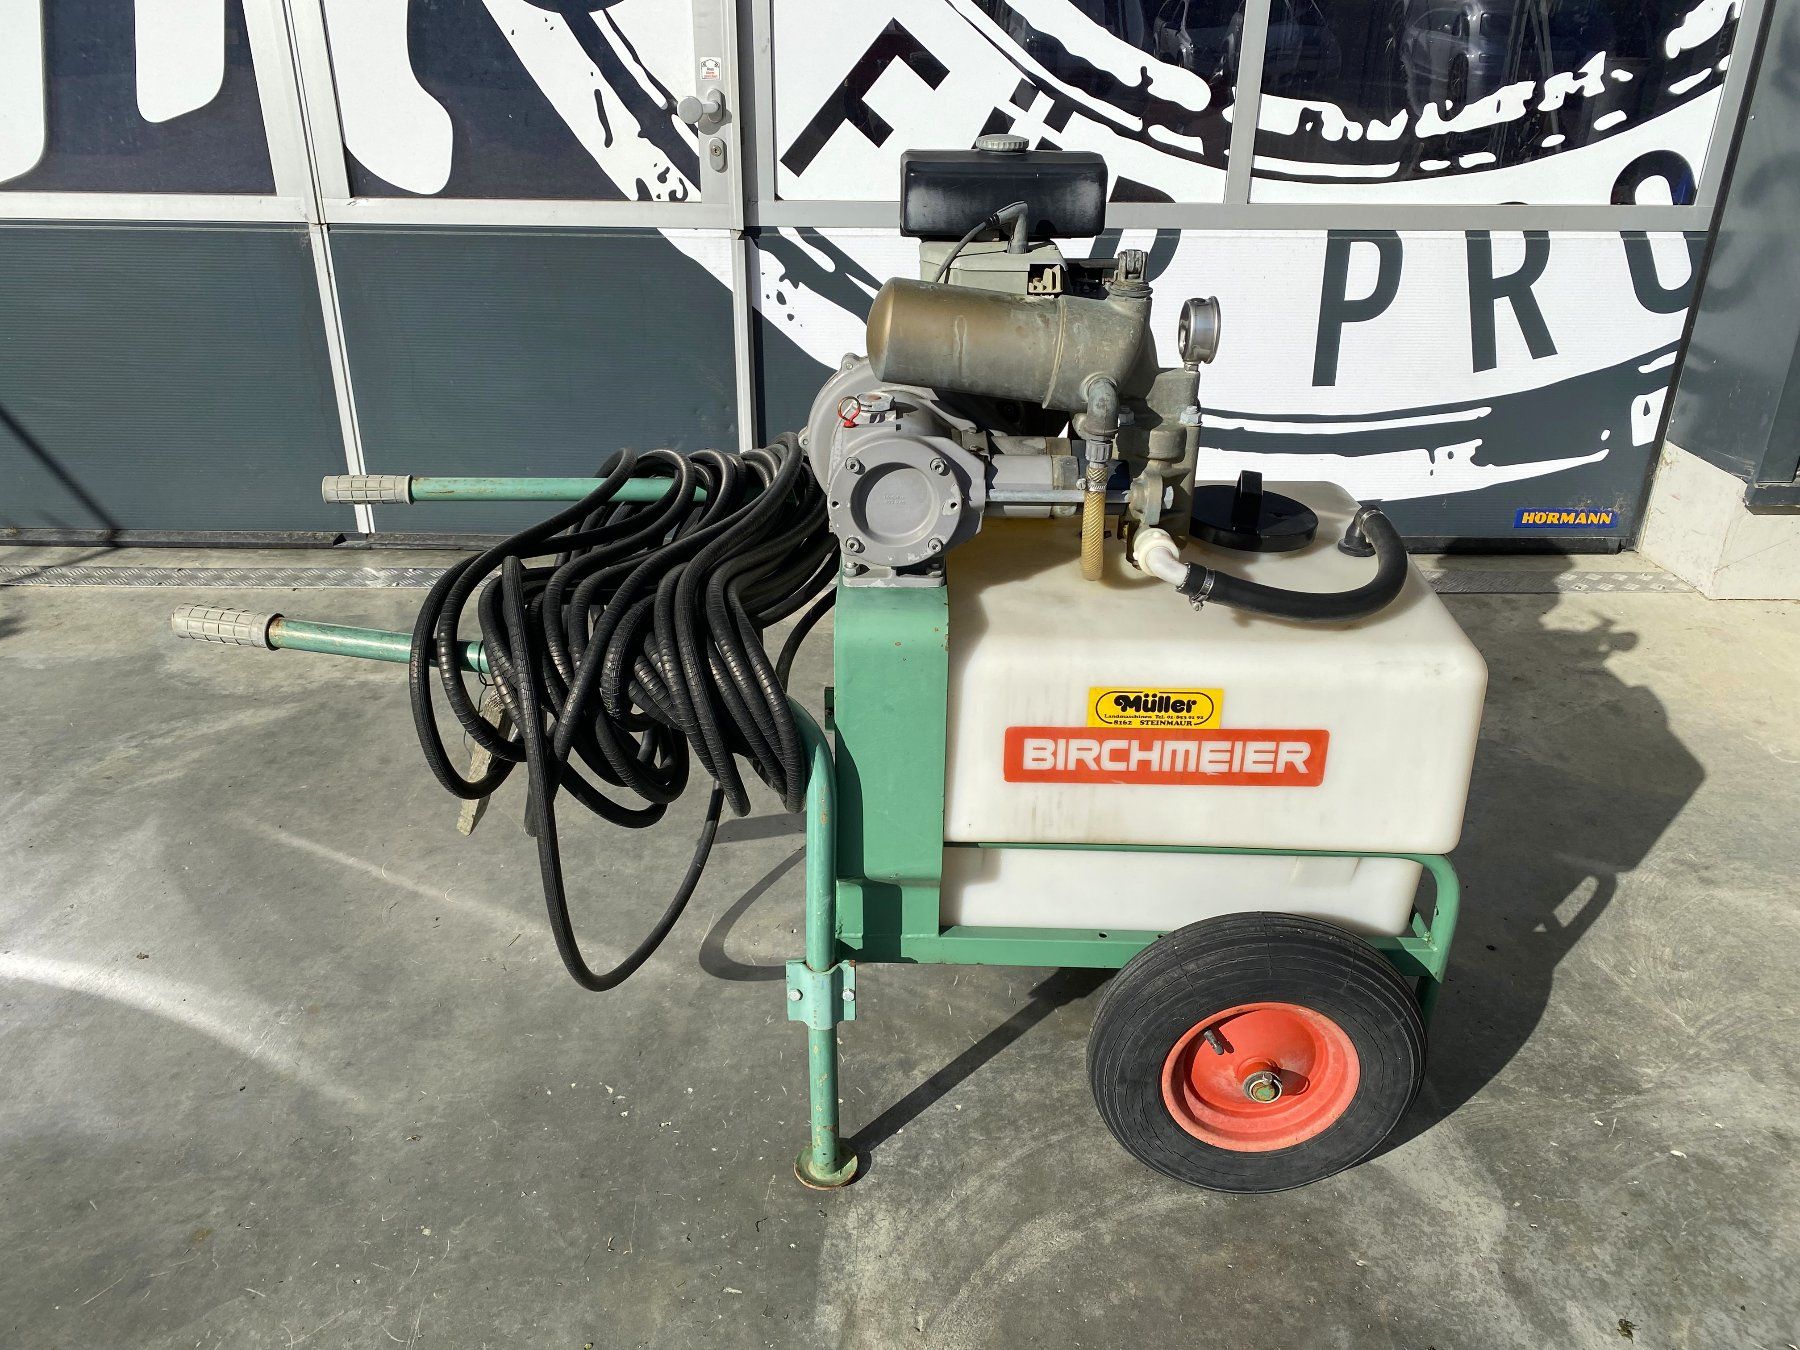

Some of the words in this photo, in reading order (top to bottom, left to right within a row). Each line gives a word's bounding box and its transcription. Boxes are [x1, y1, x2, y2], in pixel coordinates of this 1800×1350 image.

[1521, 511, 1613, 525] HÖRMANN
[1113, 693, 1198, 713] Müller
[1022, 738, 1312, 774] BIRCHMEIER
